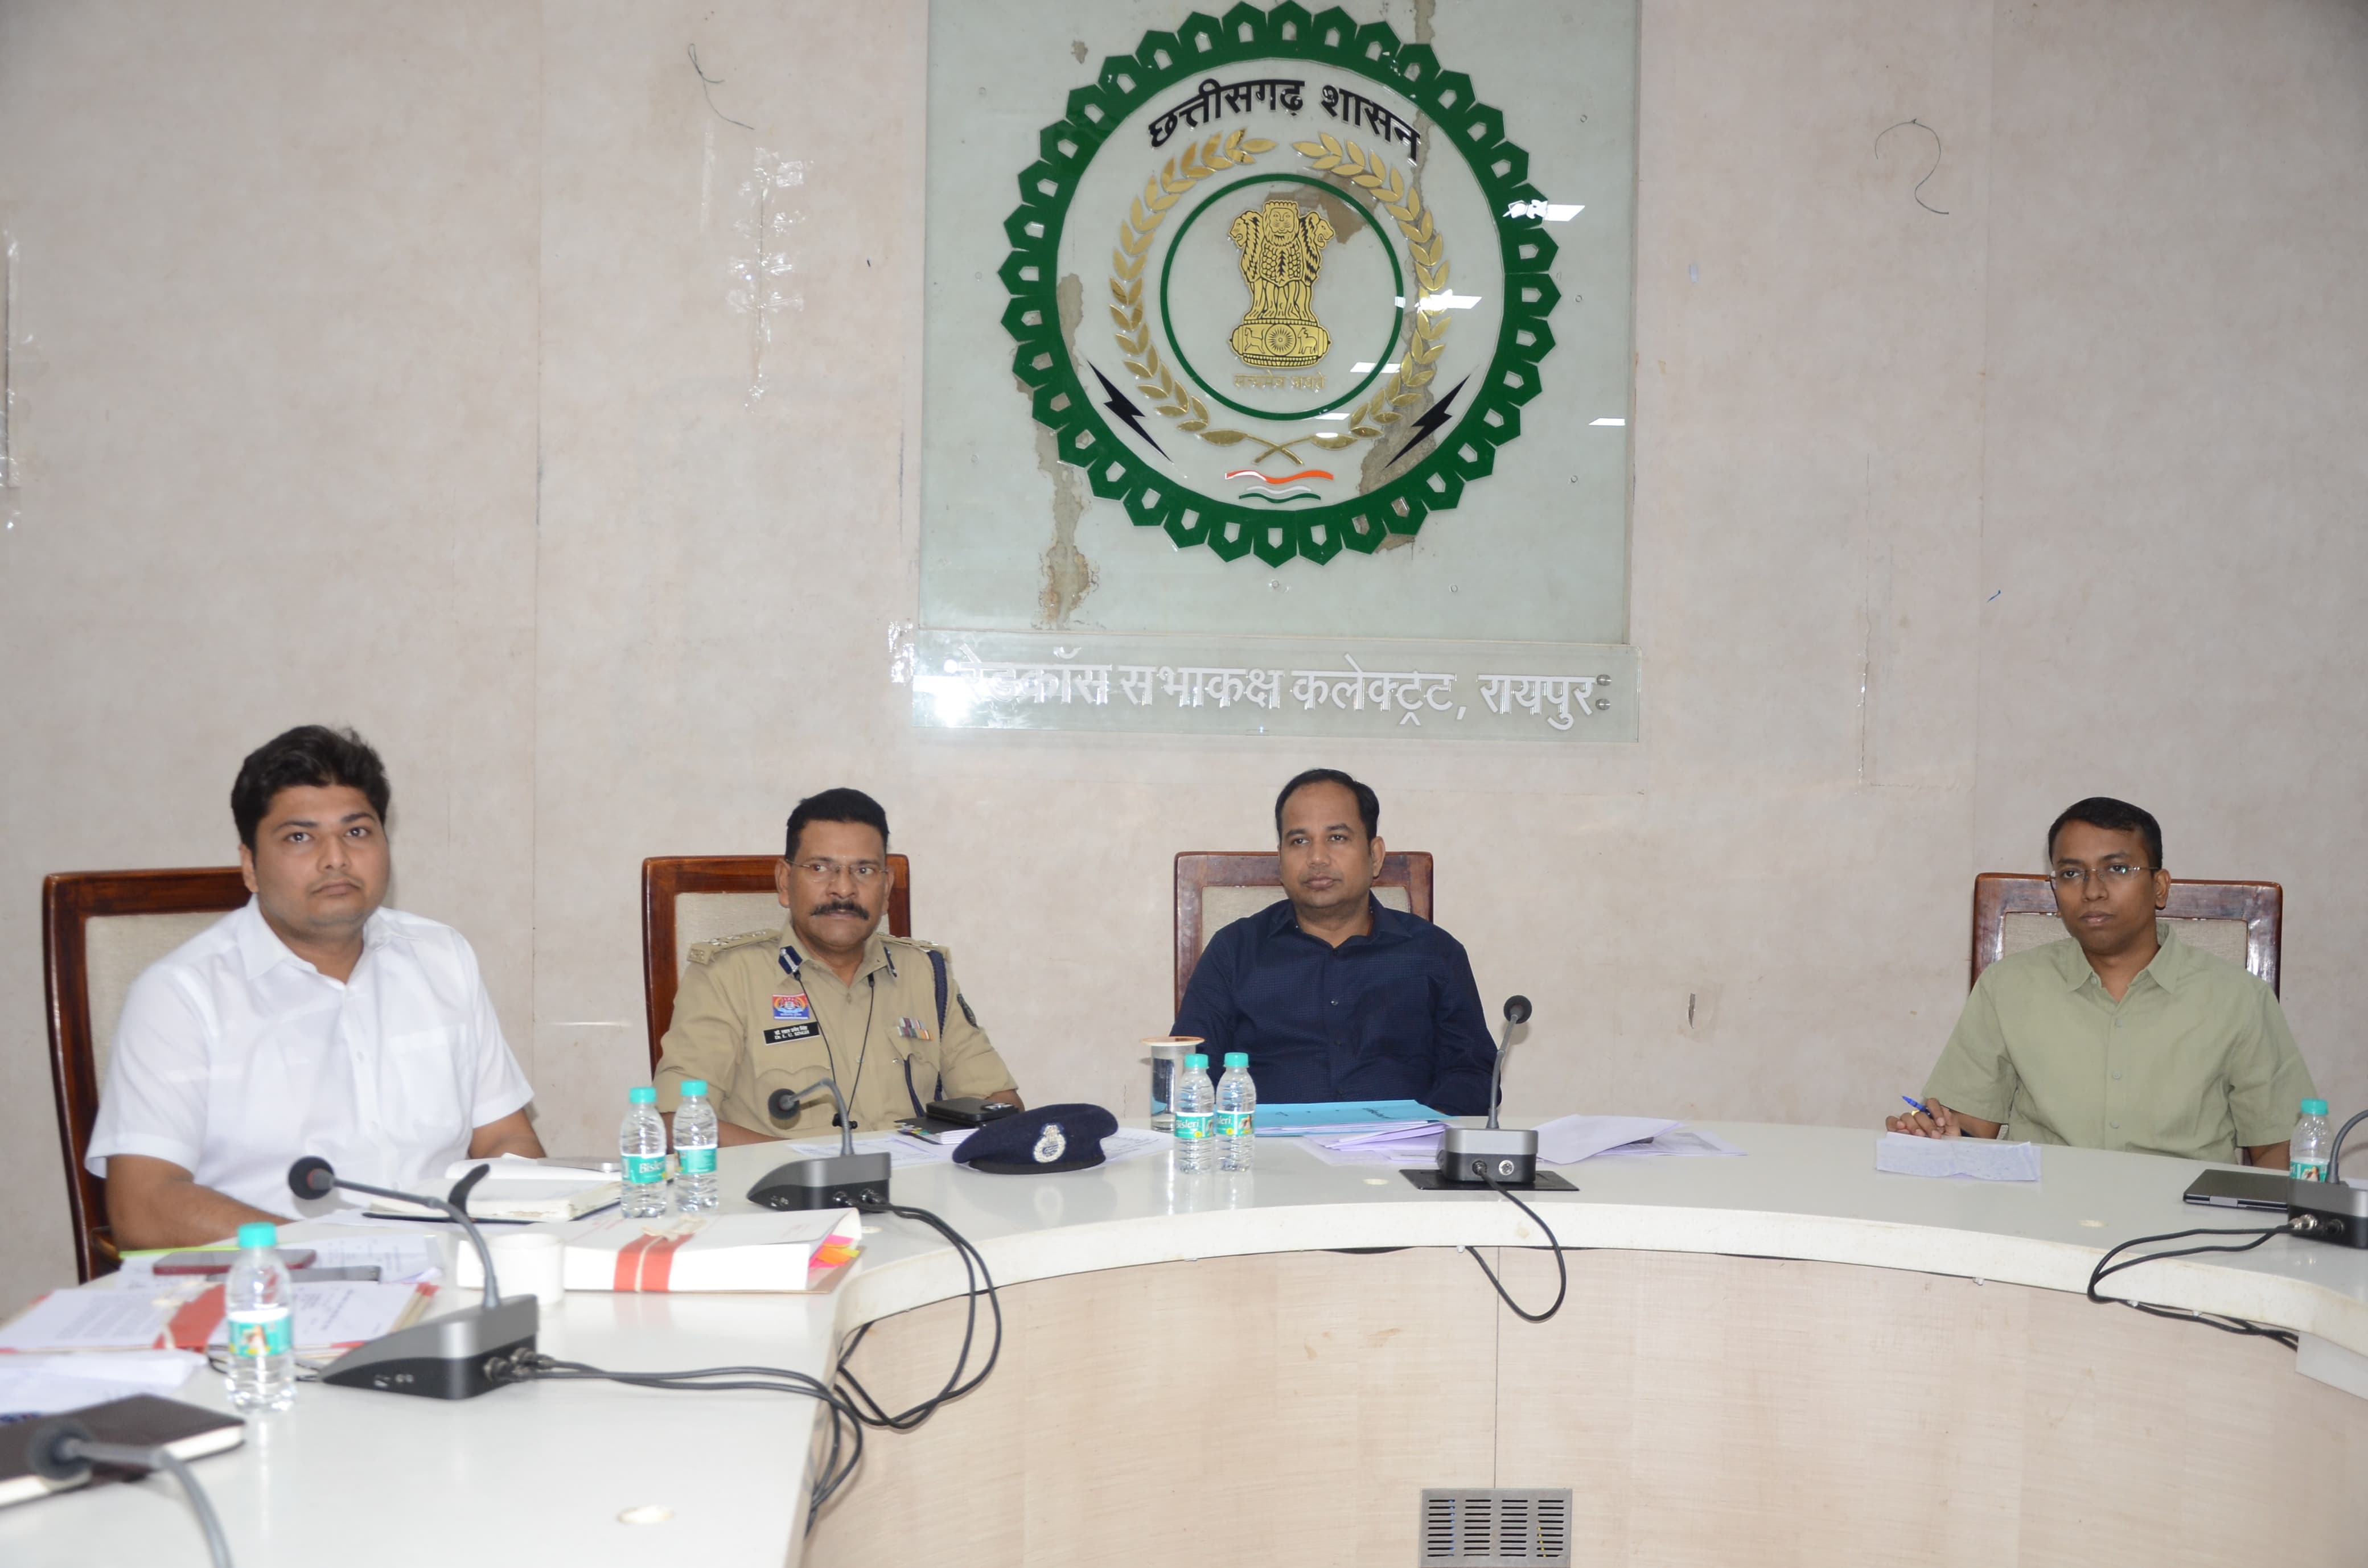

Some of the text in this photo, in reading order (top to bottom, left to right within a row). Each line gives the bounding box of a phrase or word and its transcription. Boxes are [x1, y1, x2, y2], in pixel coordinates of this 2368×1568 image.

[1148, 79, 1421, 162] छत्तीसगढ़ शासन
[1118, 665, 1285, 708] सभाकक्ष
[1477, 674, 1596, 730] रायपुर
